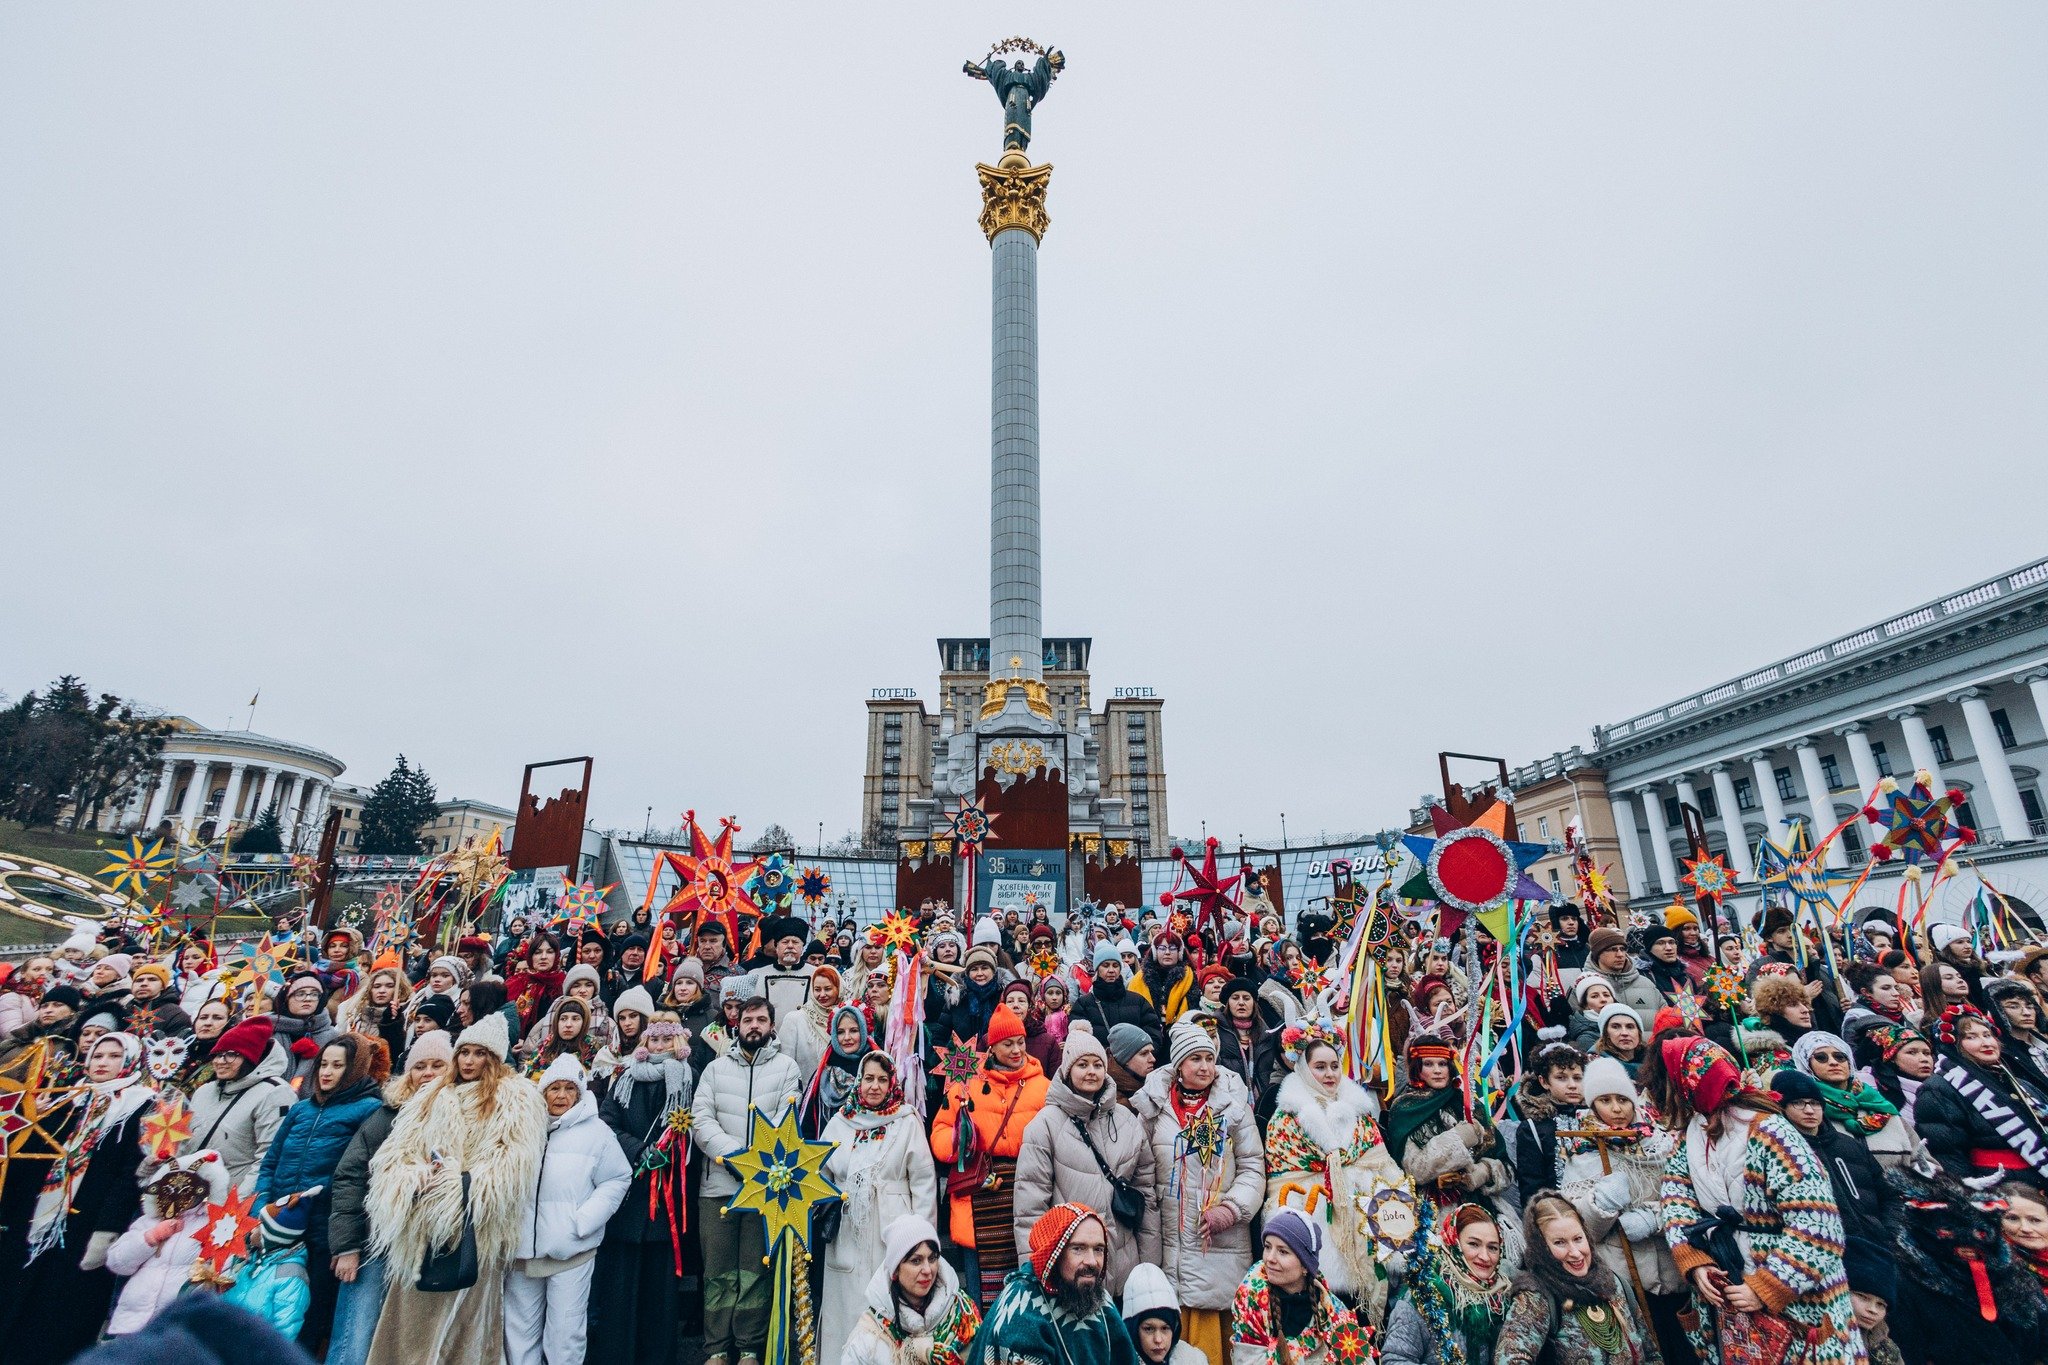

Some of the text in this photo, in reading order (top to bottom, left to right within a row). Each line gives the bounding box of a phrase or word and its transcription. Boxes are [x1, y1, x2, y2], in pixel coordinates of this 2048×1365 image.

[871, 687, 917, 698] ГОТЕЛЬ
[1114, 686, 1158, 697] HOTEL
[988, 857, 1005, 874] 35
[1005, 863, 1061, 874] НА ГРНІТІ
